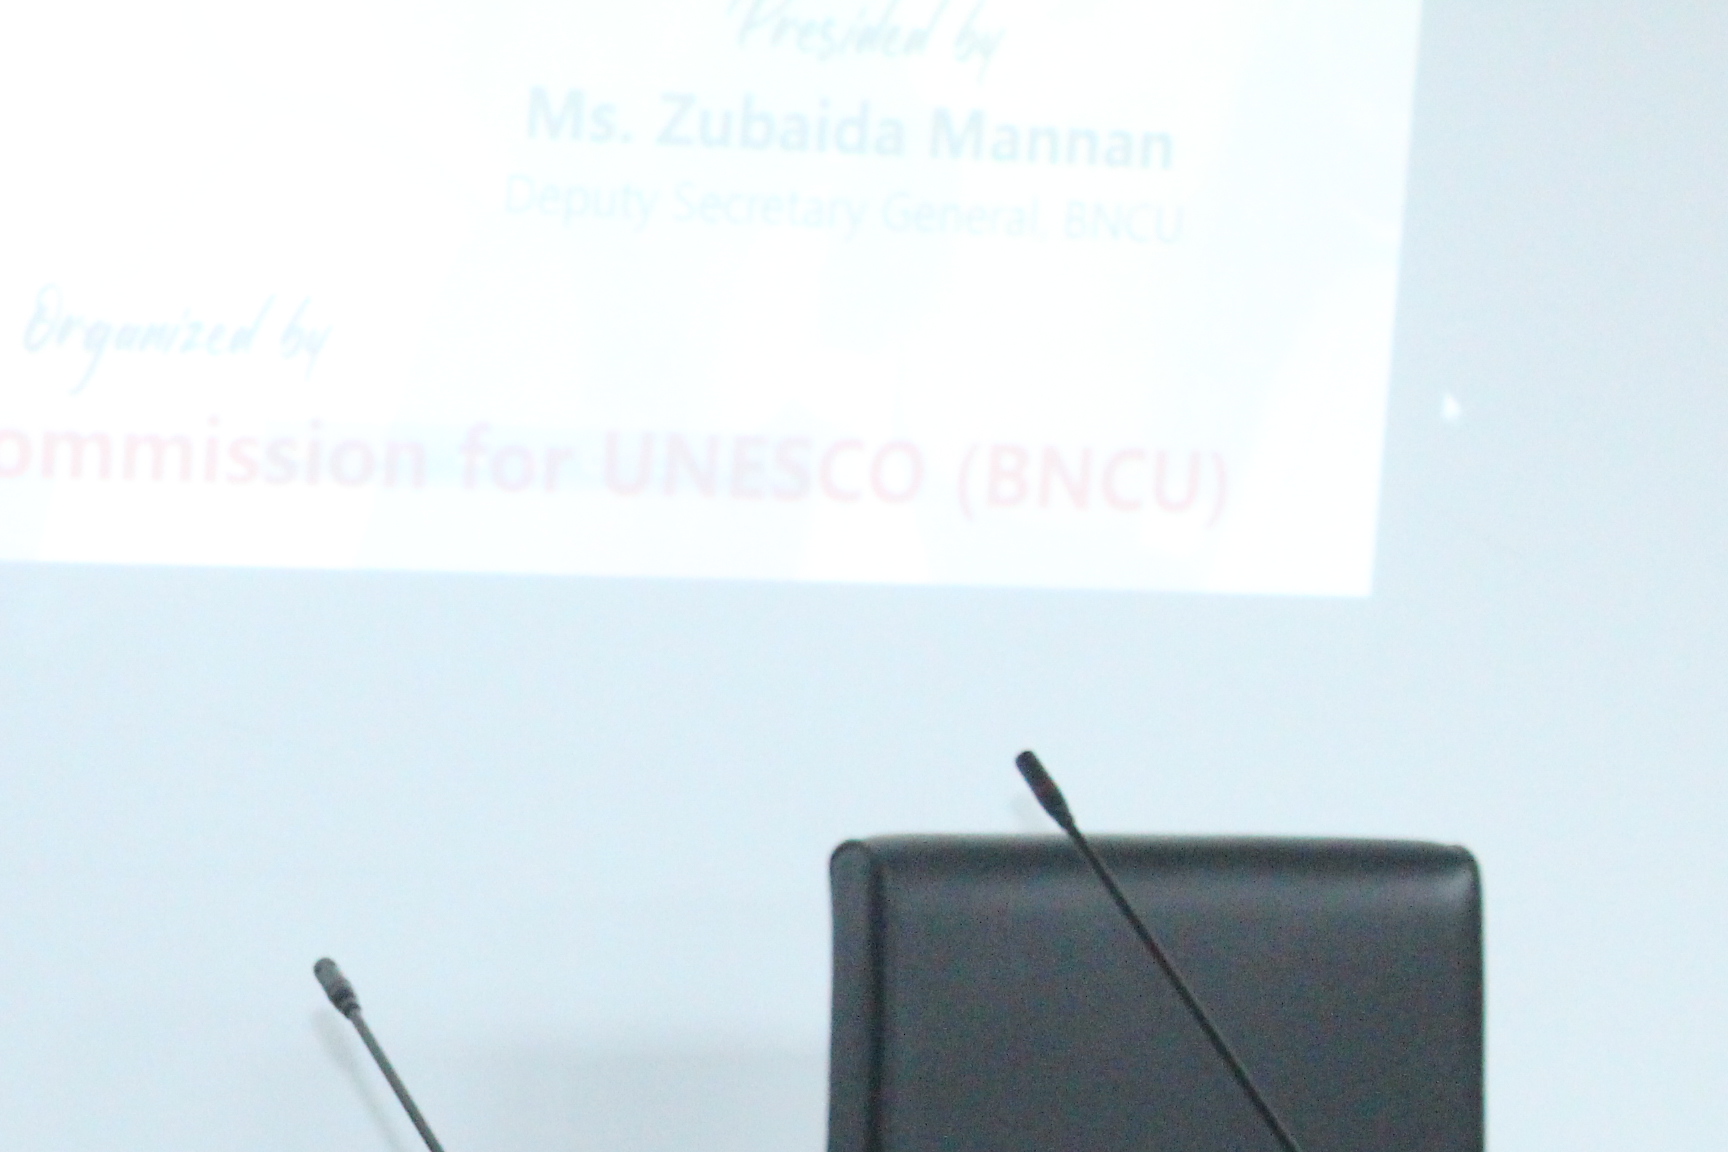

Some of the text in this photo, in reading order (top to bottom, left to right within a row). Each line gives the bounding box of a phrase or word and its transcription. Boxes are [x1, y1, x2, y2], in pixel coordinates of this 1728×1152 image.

[953, 0, 1007, 85] by
[527, 84, 1176, 170] Ms. Zubaida Mannan
[505, 173, 661, 234] Deputy
[673, 180, 869, 244] Secretary
[1063, 198, 1185, 244] BNCU
[22, 282, 334, 397] Organized by
[460, 418, 576, 494] for
[603, 427, 925, 504] UNESCO
[957, 440, 1228, 528] (BNCU)
